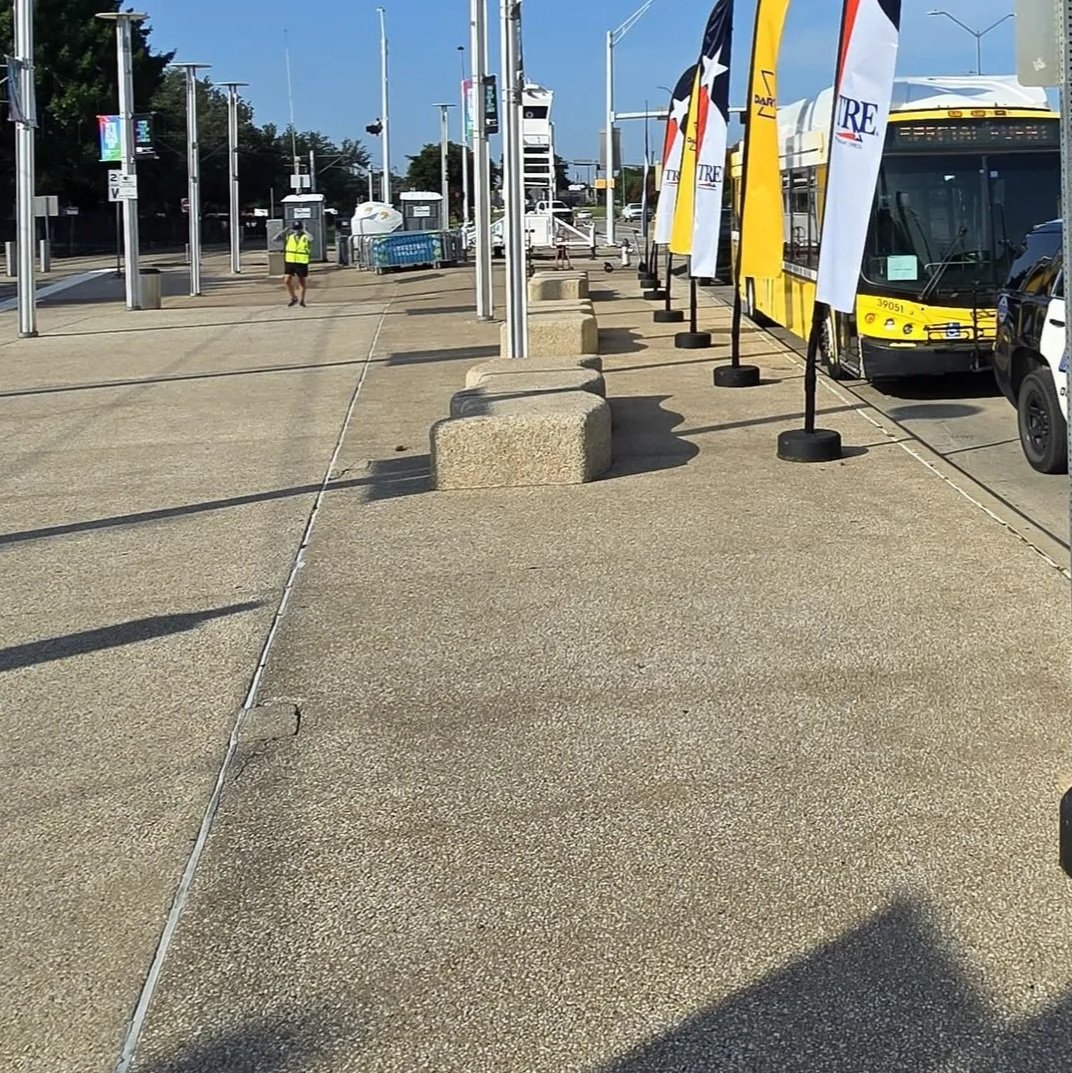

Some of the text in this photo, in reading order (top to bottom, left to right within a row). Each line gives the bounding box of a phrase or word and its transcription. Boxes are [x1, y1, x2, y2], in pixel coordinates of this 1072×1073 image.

[837, 94, 878, 136] TRE
[698, 164, 722, 183] TRE
[877, 298, 904, 314] 39051
